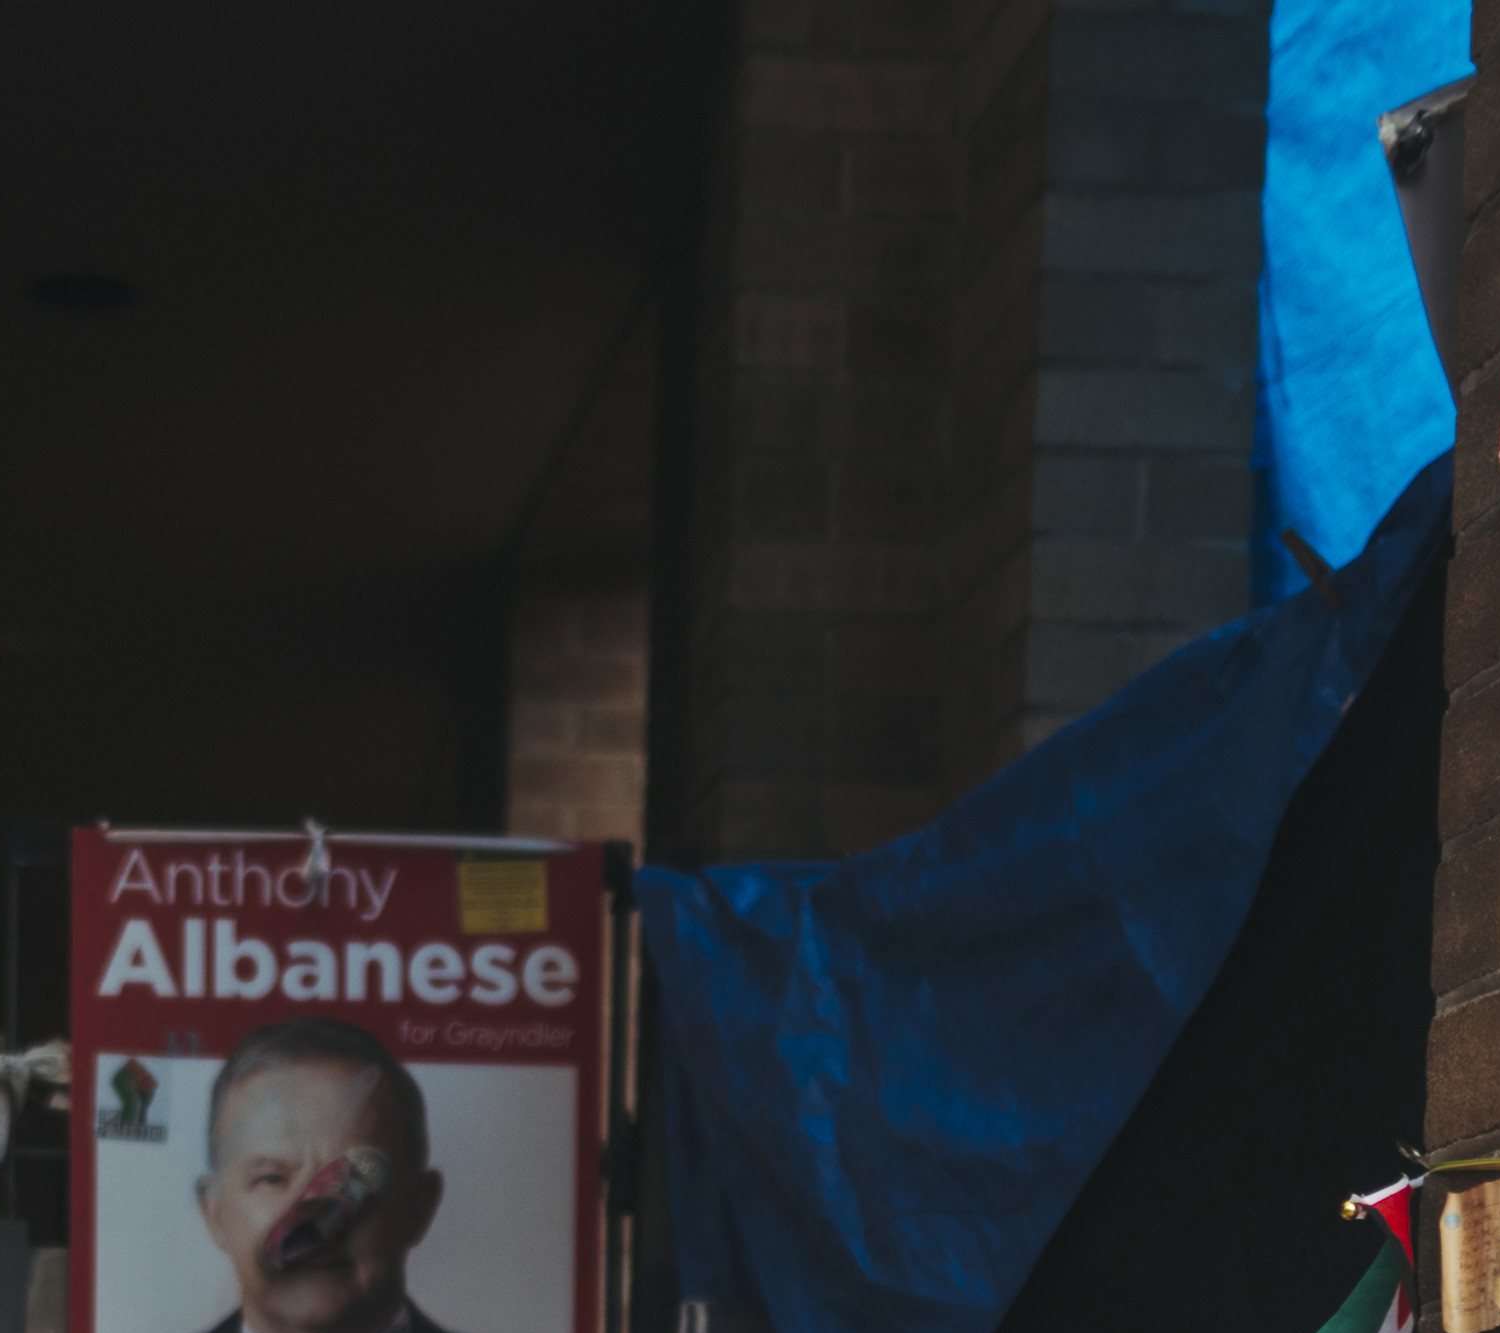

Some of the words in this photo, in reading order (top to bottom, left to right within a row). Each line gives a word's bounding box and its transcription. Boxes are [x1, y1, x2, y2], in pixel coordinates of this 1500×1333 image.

[110, 848, 398, 921] Anthony
[98, 918, 580, 1007] Albanese
[400, 1019, 438, 1047] for
